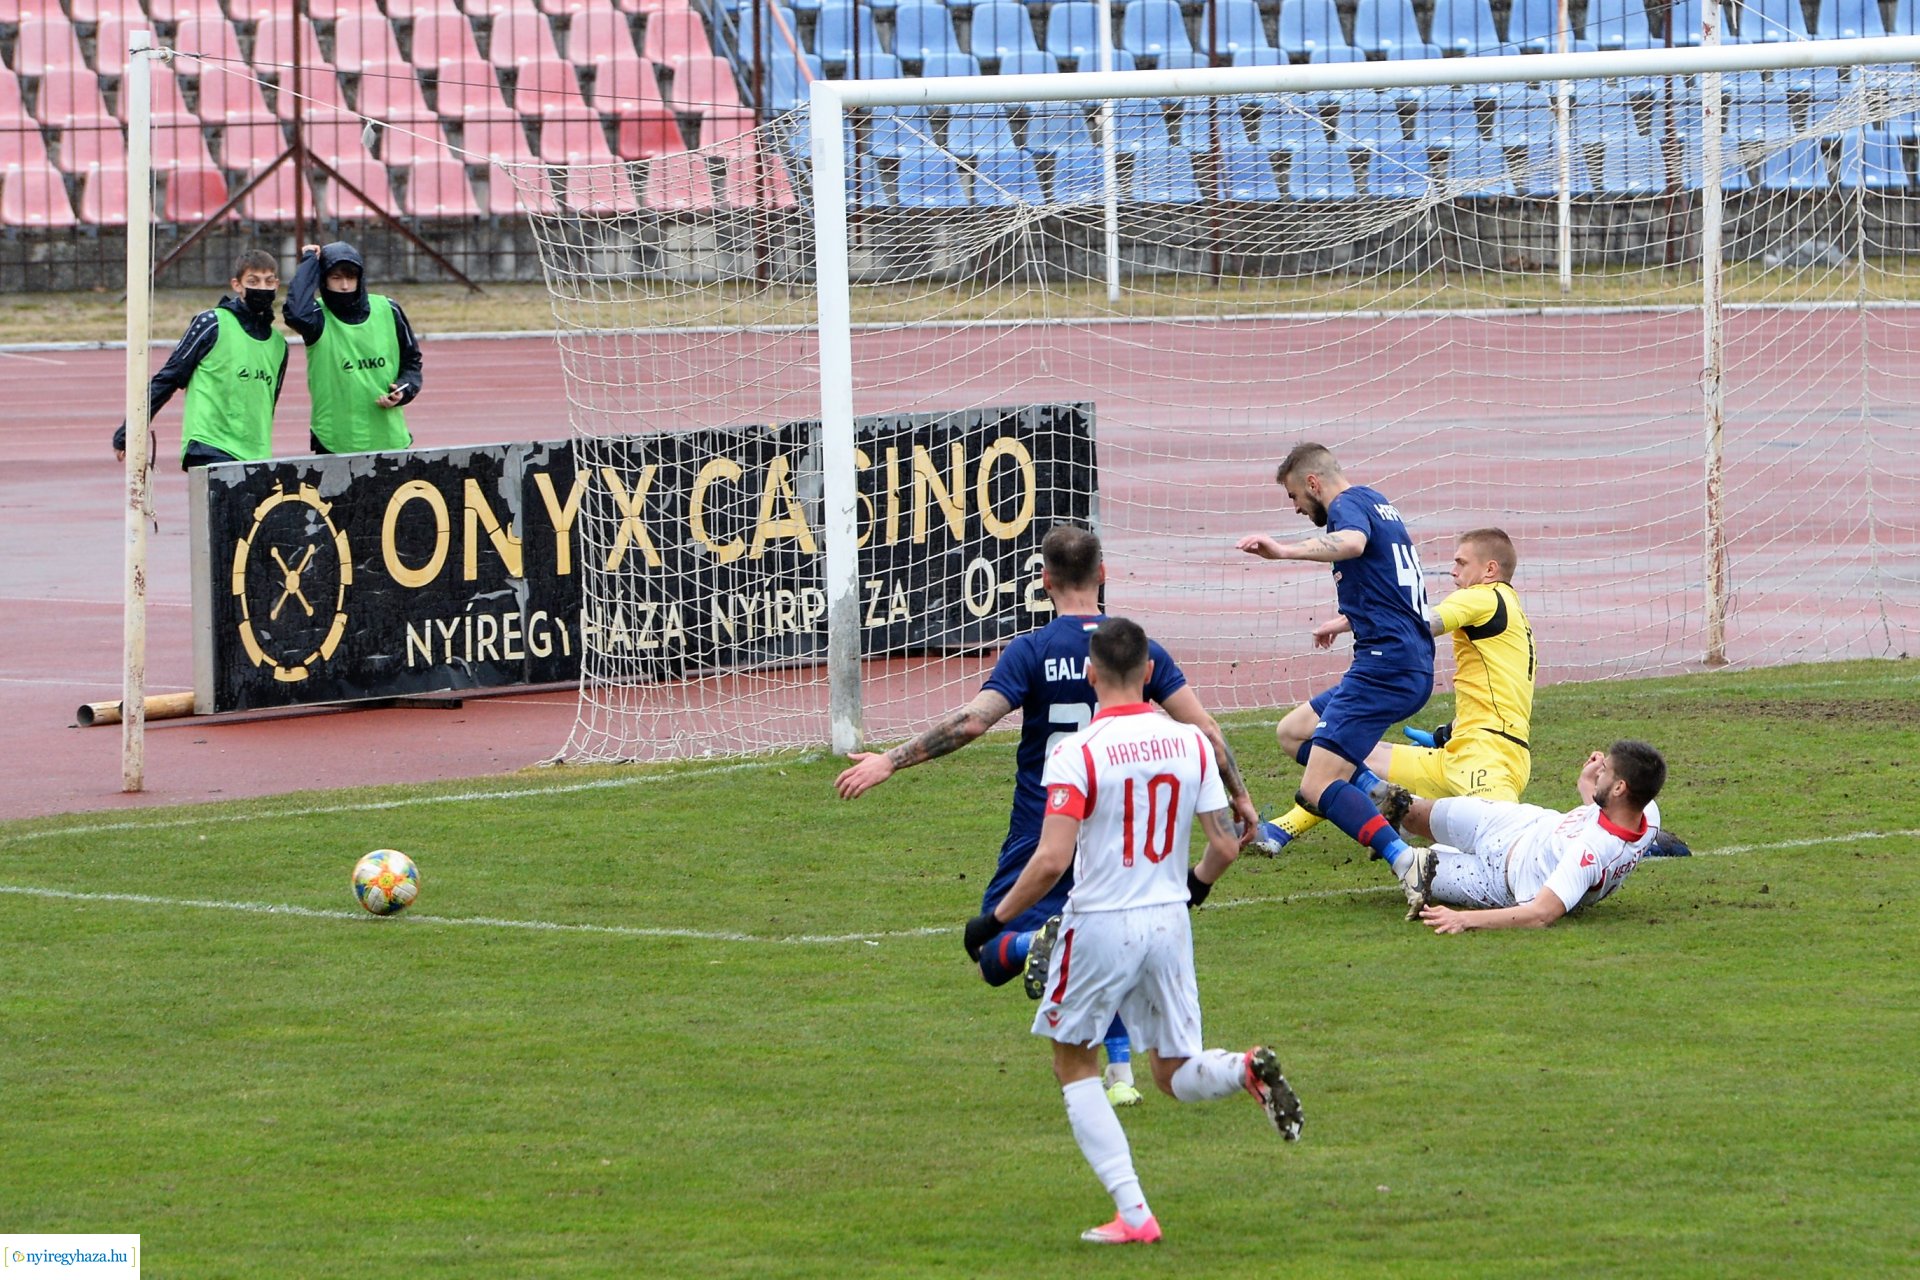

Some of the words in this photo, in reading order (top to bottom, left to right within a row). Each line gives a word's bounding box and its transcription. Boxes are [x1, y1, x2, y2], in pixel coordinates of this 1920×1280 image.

[254, 370, 272, 386] JAO
[357, 357, 386, 370] JAKO
[381, 464, 662, 588] ONYX
[710, 577, 912, 645] NYÍRPZA
[1106, 734, 1187, 767] HARSÁNYI
[1470, 769, 1487, 789] 12
[1122, 773, 1181, 868] 10
